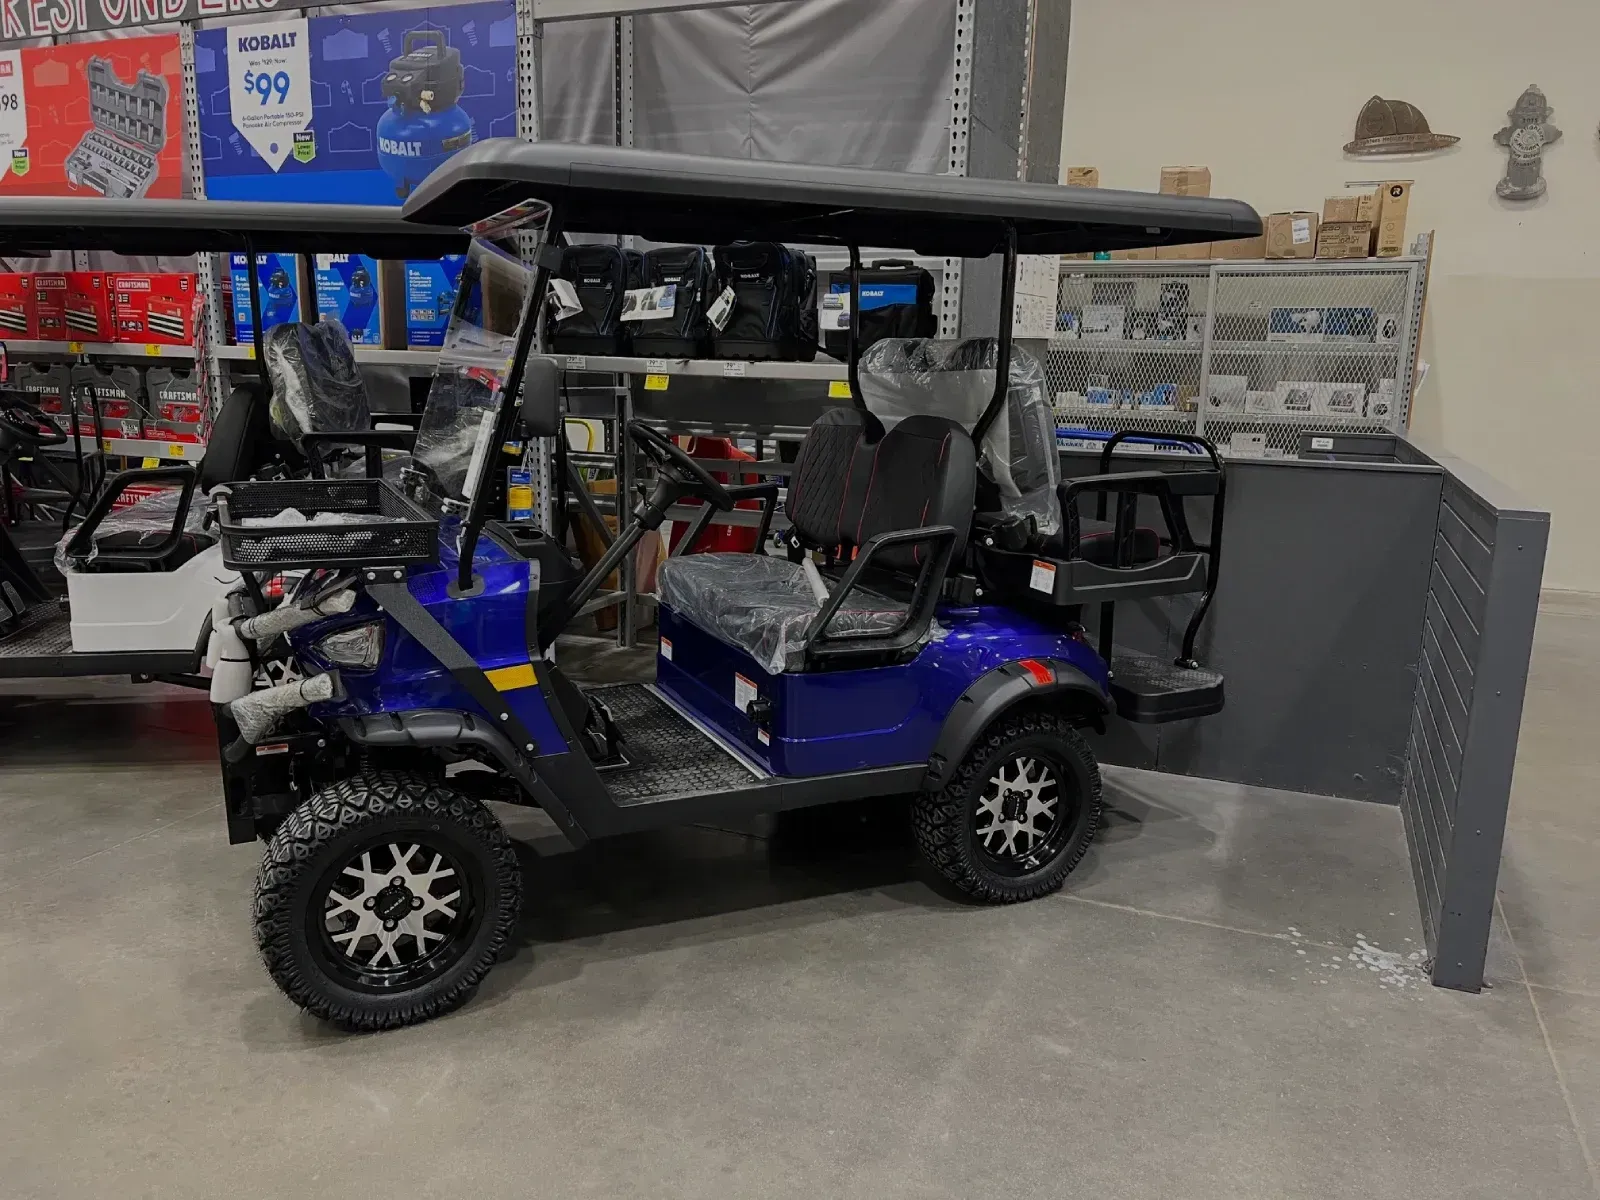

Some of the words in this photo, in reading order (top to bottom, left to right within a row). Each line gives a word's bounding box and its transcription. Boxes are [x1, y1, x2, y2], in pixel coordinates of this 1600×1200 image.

[238, 32, 297, 53] KOBALT
[244, 69, 290, 105] $99
[296, 133, 311, 141] New
[379, 136, 422, 156] KOBALT
[233, 255, 267, 265] KOLT
[37, 279, 65, 287] CRAFTSMAN
[118, 280, 149, 289] CRAFTSMAN
[25, 385, 60, 394] CRAFTSMAN
[84, 386, 126, 398] CFTSMAN
